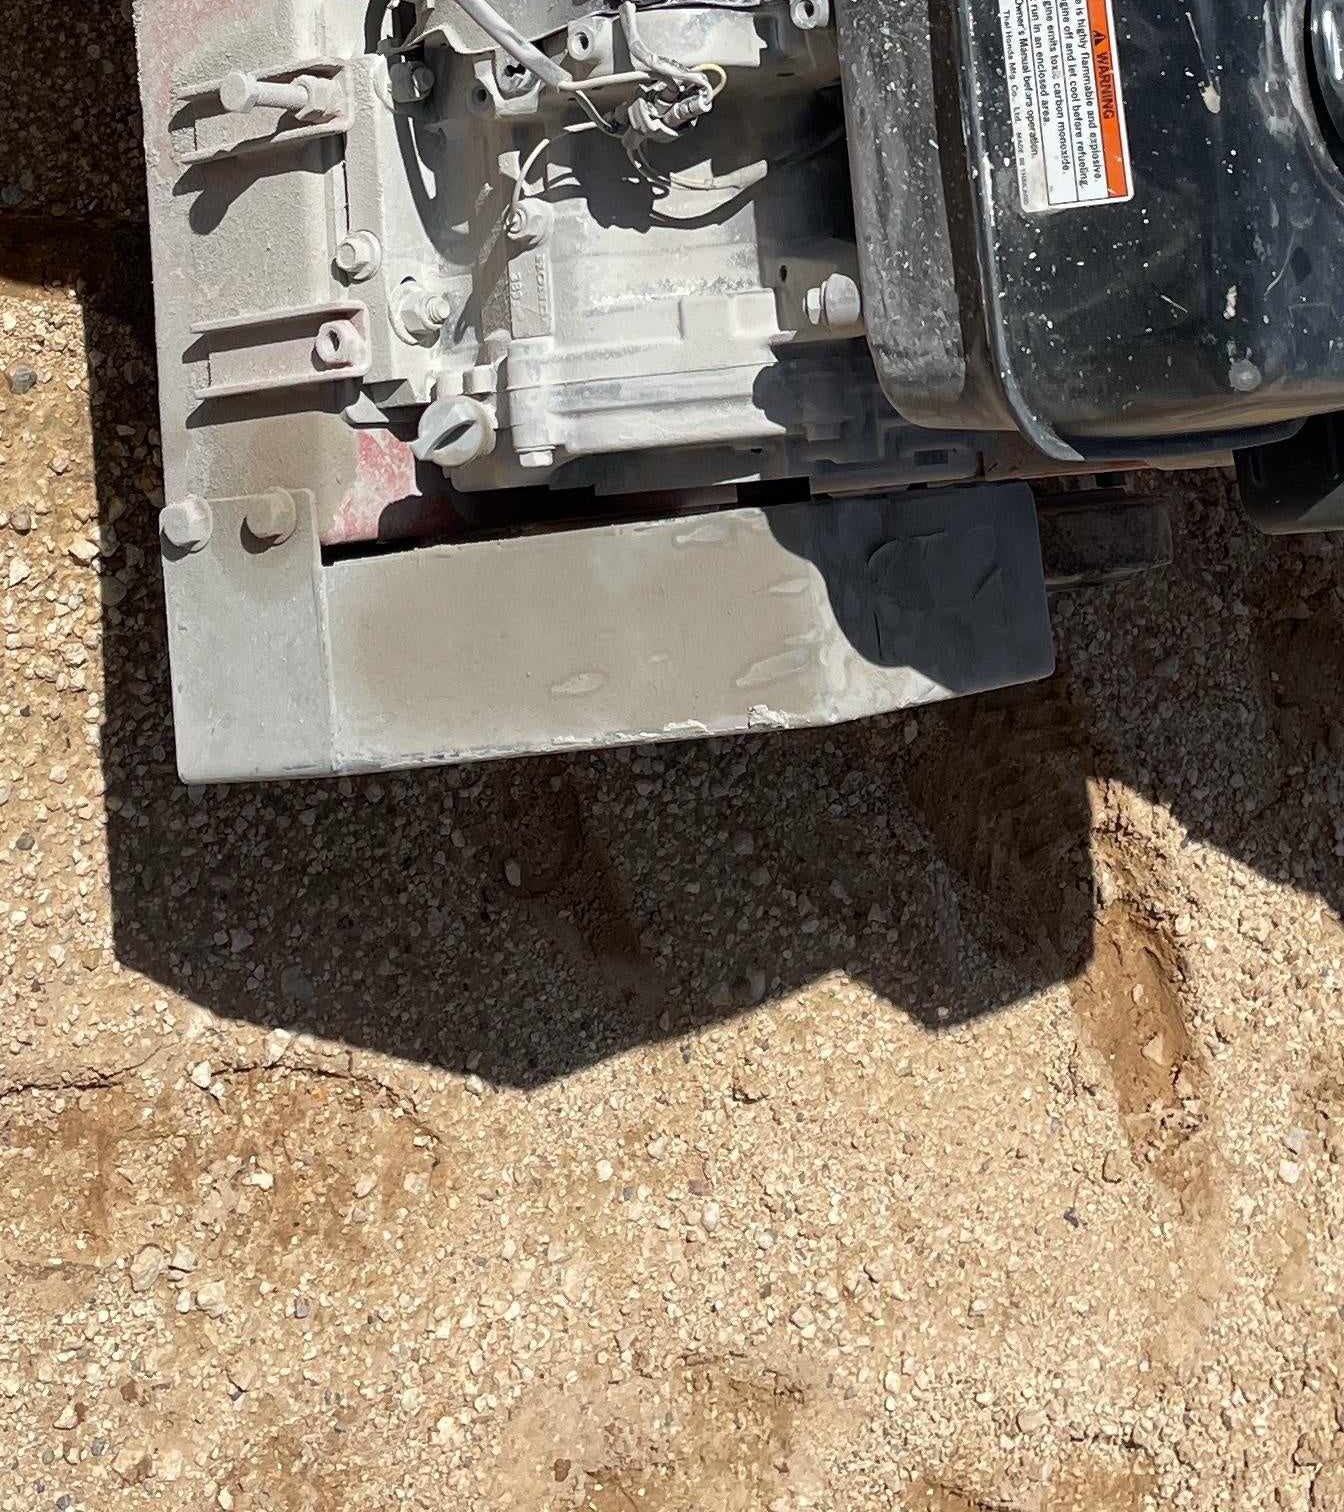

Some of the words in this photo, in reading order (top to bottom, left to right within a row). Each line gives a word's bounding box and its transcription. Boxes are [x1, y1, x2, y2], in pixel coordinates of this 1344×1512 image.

[1002, 9, 1011, 28] Thai
[1030, 4, 1039, 20] run
[1075, 7, 1085, 15] is
[1032, 23, 1041, 33] in
[1063, 25, 1073, 40] off
[1074, 18, 1088, 49] highly
[1005, 31, 1014, 59] Honda
[1034, 36, 1042, 48] an
[1065, 42, 1075, 61] and
[1019, 38, 1029, 73] Manual
[1036, 51, 1047, 96] enclosed
[1046, 24, 1057, 52] emits
[1053, 82, 1064, 118] carbon
[1067, 64, 1077, 77] let
[1080, 51, 1094, 106] flammable
[1022, 75, 1034, 107] before
[1069, 80, 1079, 102] cool
[1097, 51, 1114, 119] WARNING
[1040, 99, 1051, 126] area.
[1072, 104, 1083, 137] before
[1086, 109, 1096, 128] and
